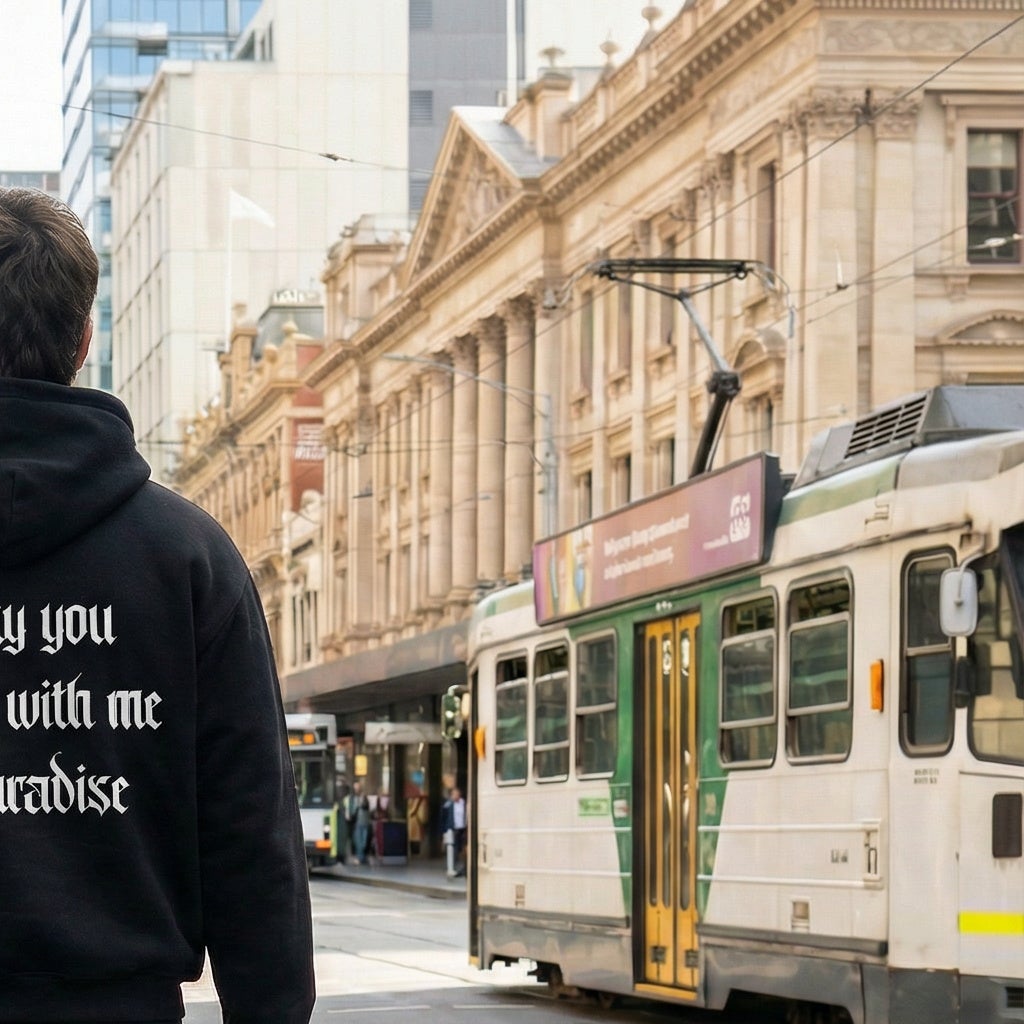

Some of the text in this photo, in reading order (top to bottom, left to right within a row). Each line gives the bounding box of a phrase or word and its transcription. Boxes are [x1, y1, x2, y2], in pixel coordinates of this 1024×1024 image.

[40, 603, 117, 654] you
[7, 673, 96, 730] with
[107, 690, 162, 730] me
